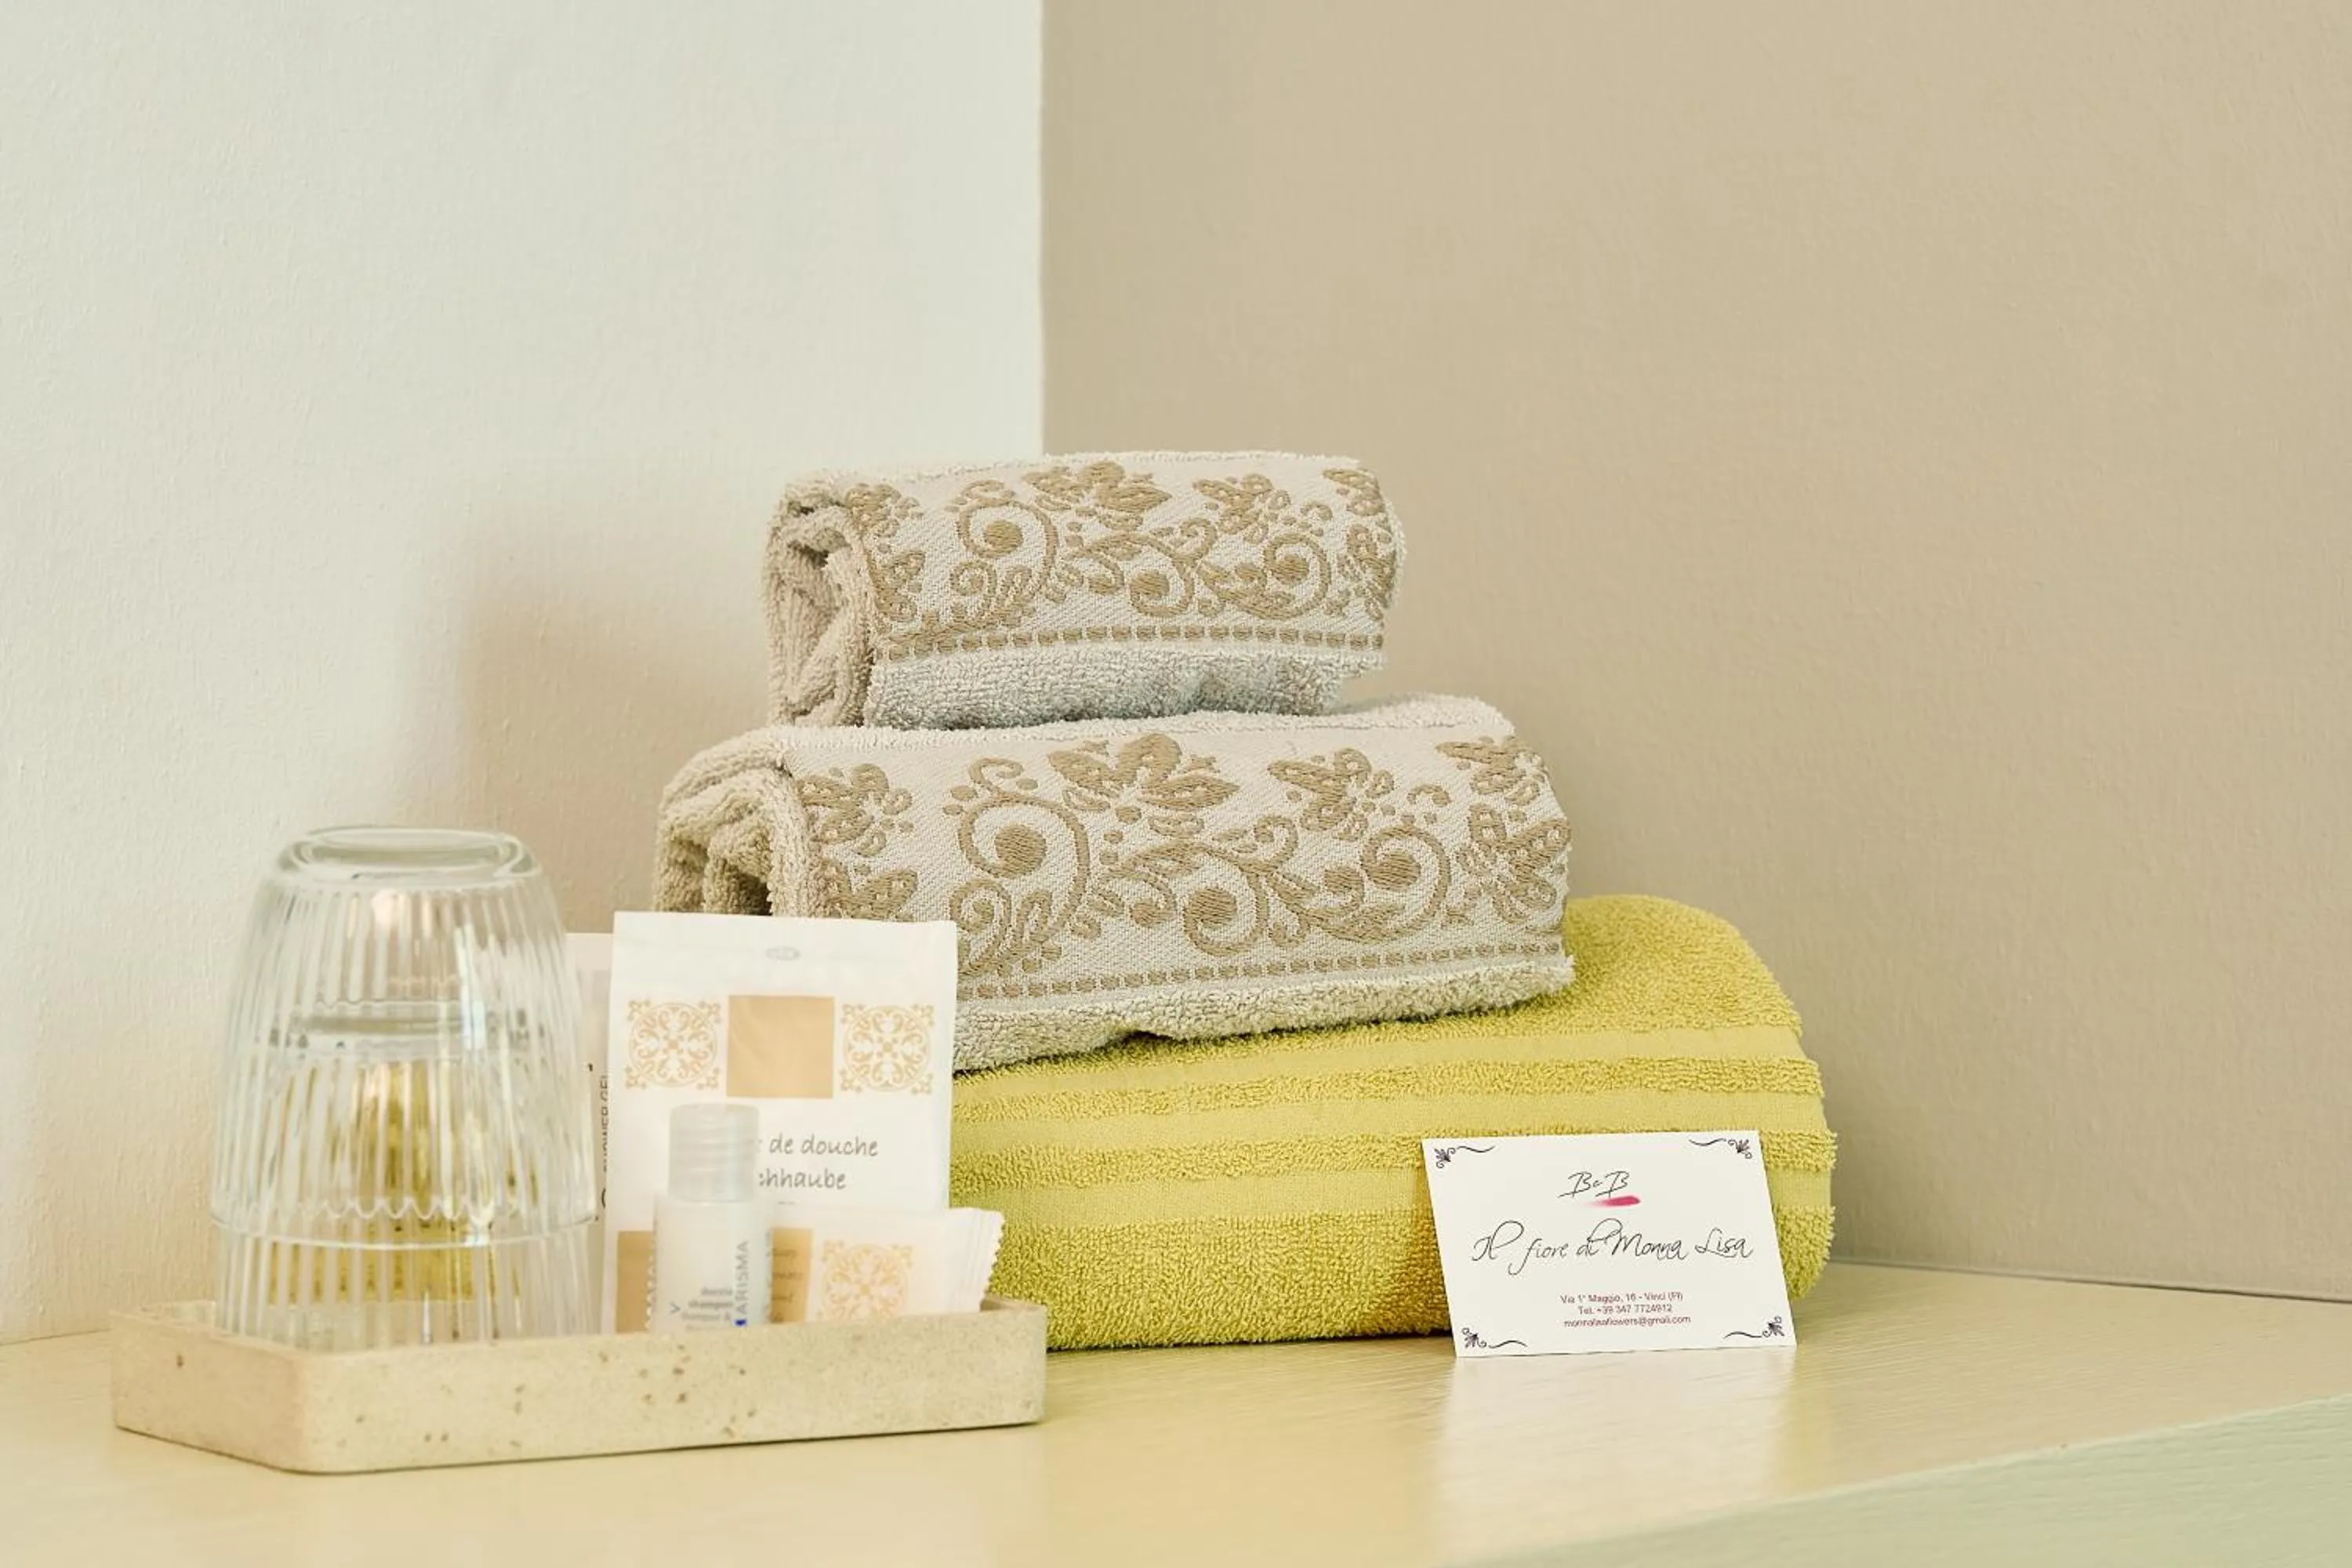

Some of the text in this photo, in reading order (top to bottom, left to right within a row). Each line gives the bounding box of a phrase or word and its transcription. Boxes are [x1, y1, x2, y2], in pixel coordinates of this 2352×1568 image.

[769, 1132, 879, 1156] de douche
[1472, 1218, 1754, 1276] Il fiore di Monna Lisa
[1560, 1294, 1575, 1304] Via
[1588, 1294, 1624, 1305] Maggio,
[1644, 1292, 1666, 1301] Vinci
